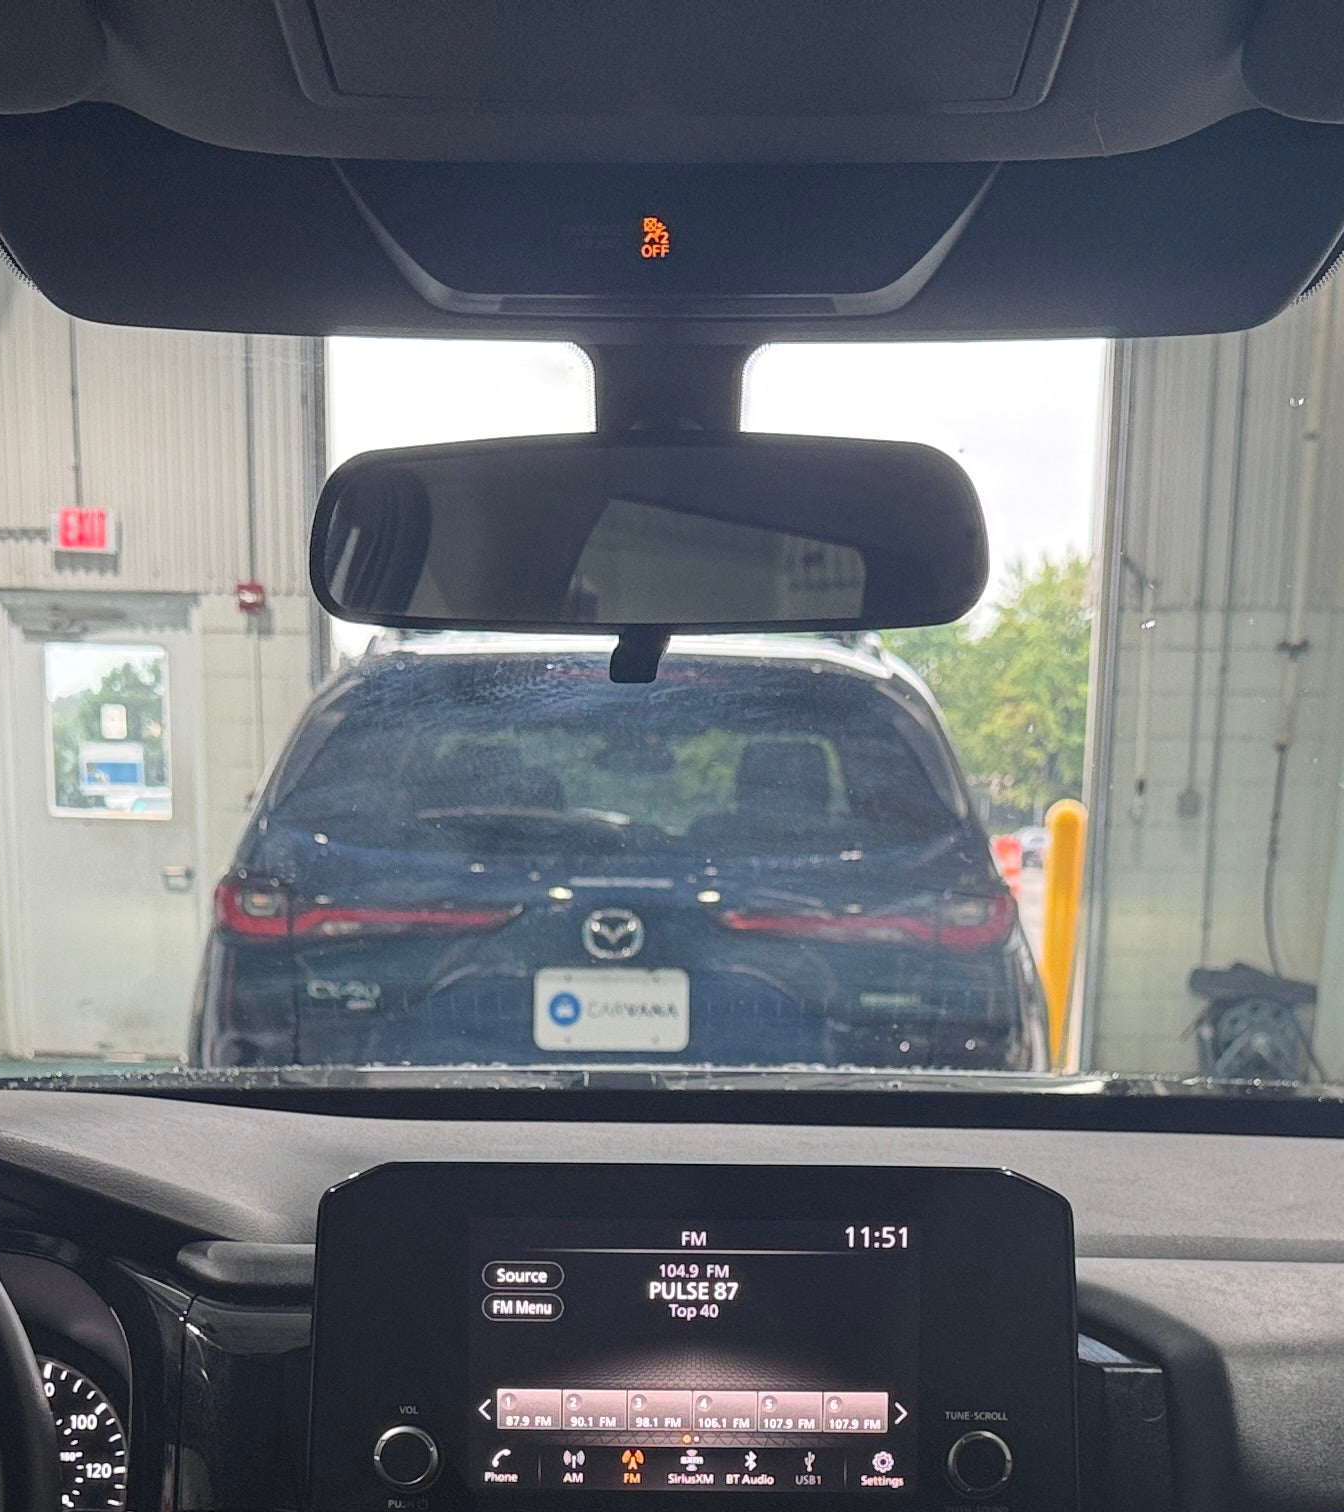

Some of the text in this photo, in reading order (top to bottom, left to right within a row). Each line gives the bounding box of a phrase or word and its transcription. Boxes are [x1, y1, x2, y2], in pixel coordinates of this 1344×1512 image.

[640, 245, 670, 258] OFF
[61, 509, 106, 549] EXIT
[681, 1226, 909, 1249] FM 11:51
[496, 1267, 548, 1284] Source
[658, 1264, 730, 1279] 104.9 FM
[648, 1283, 739, 1300] PULSE 87
[492, 1301, 552, 1315] FM Menu
[668, 1304, 719, 1320] Top 40
[504, 1396, 512, 1407] 1
[569, 1396, 577, 1407] 2
[634, 1397, 643, 1408] 3
[699, 1398, 708, 1409] 4
[764, 1399, 773, 1410] 5
[830, 1400, 838, 1411] 6
[399, 1405, 419, 1415] VOL
[69, 1414, 98, 1430] 100
[505, 1416, 552, 1427] 87.9 FM
[570, 1416, 617, 1427] 90.1 FM
[635, 1416, 682, 1428] 98.1 FM
[698, 1417, 750, 1429] 106.1 FM
[763, 1417, 816, 1430] 107.9 FM
[829, 1418, 881, 1430] 107.9 FM
[85, 1463, 113, 1479] 120
[484, 1471, 519, 1483] Phone
[562, 1473, 584, 1484] AM
[623, 1473, 641, 1484] FM
[667, 1473, 714, 1485] SiriusXM
[725, 1474, 775, 1486] BT Audio
[795, 1475, 822, 1485] USB1
[860, 1475, 904, 1488] Settings
